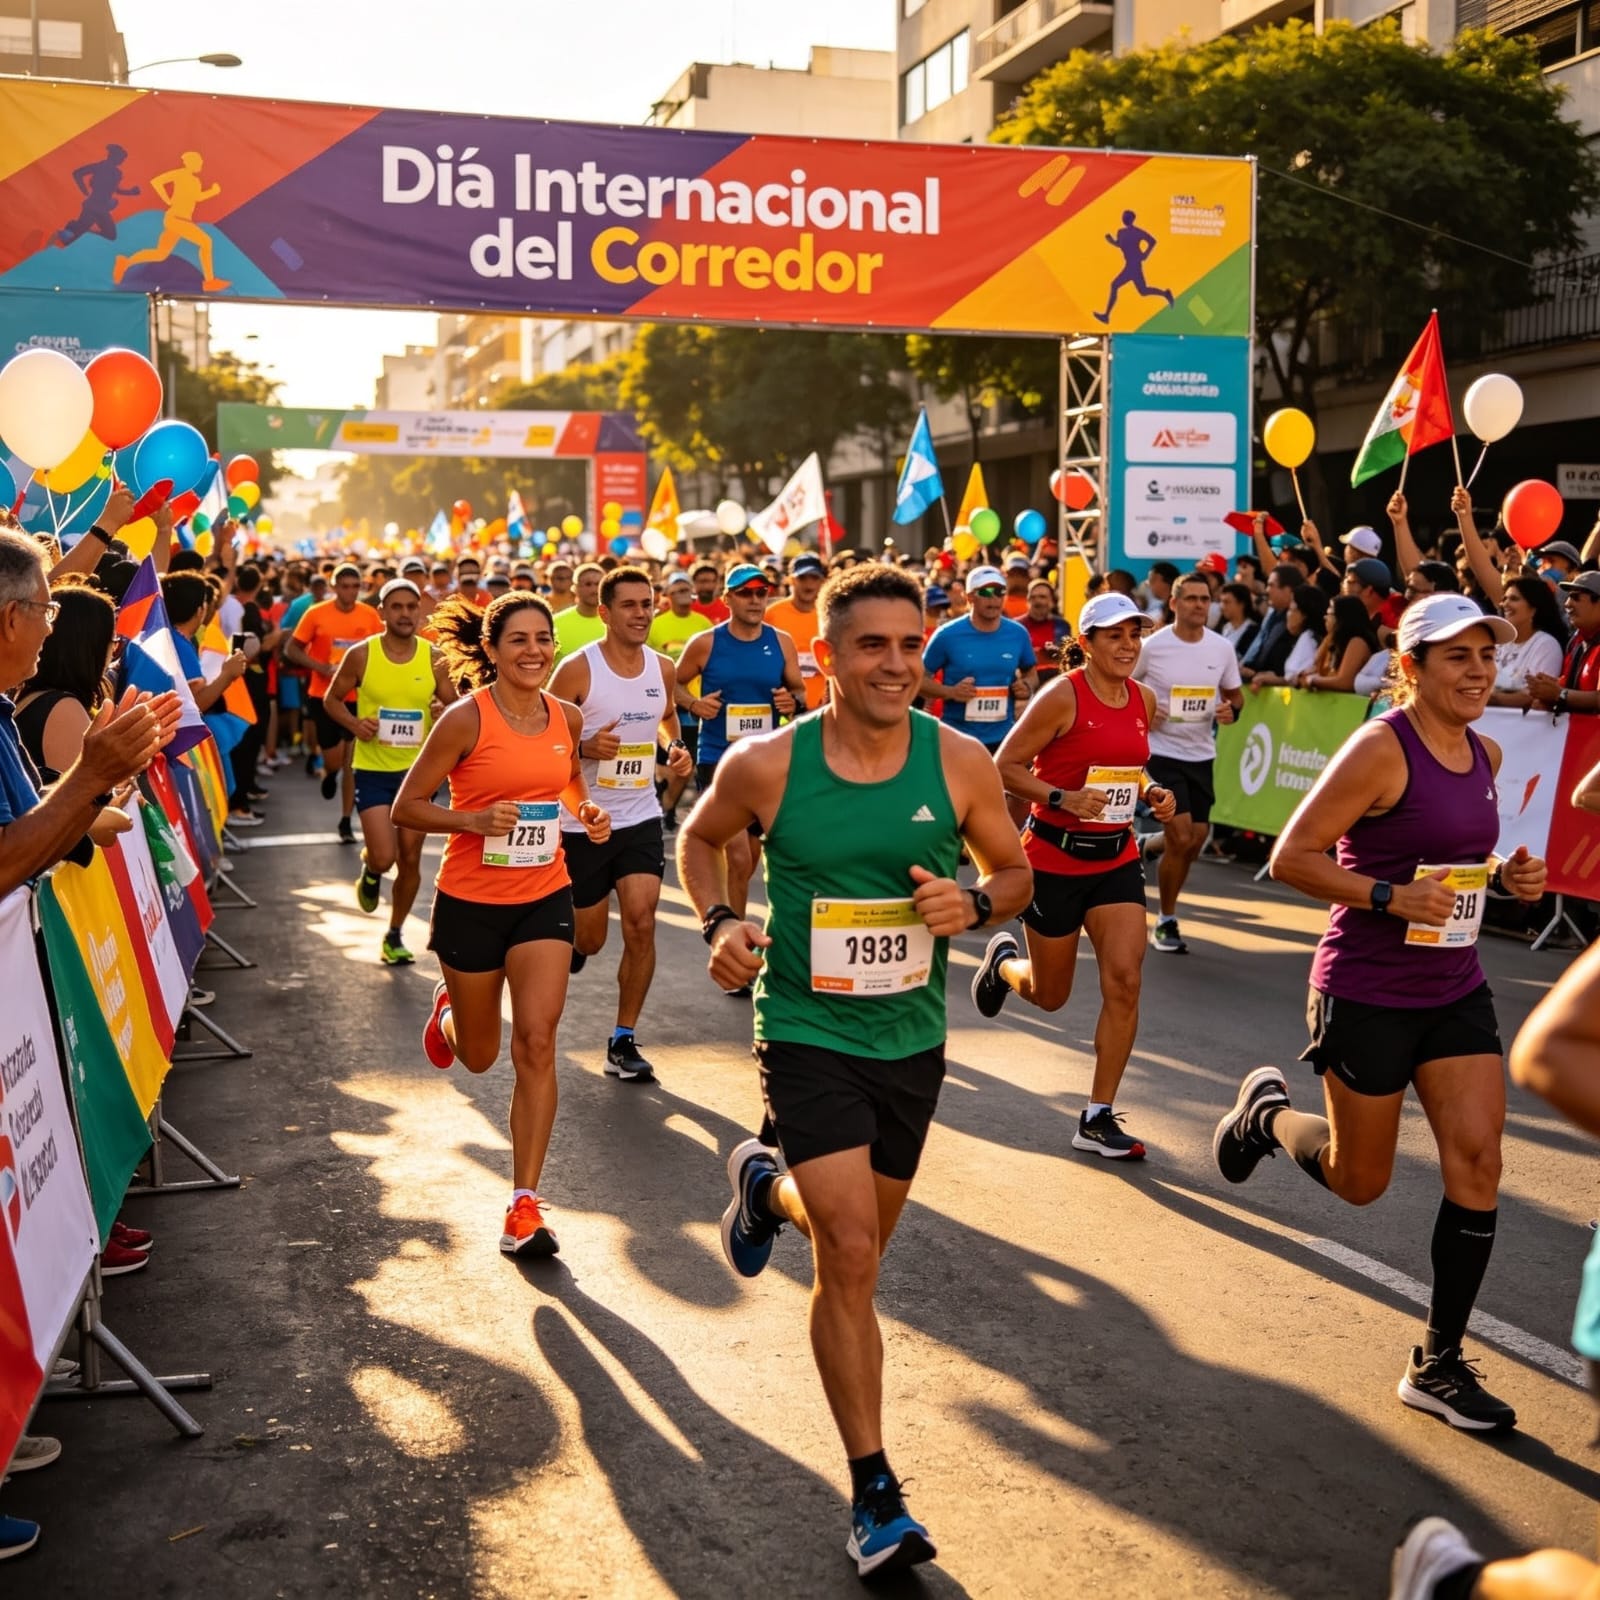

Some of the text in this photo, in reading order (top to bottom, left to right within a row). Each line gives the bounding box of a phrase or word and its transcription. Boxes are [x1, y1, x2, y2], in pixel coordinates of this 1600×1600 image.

[382, 144, 940, 235] Diá Internacional
[469, 218, 884, 294] del Corredor
